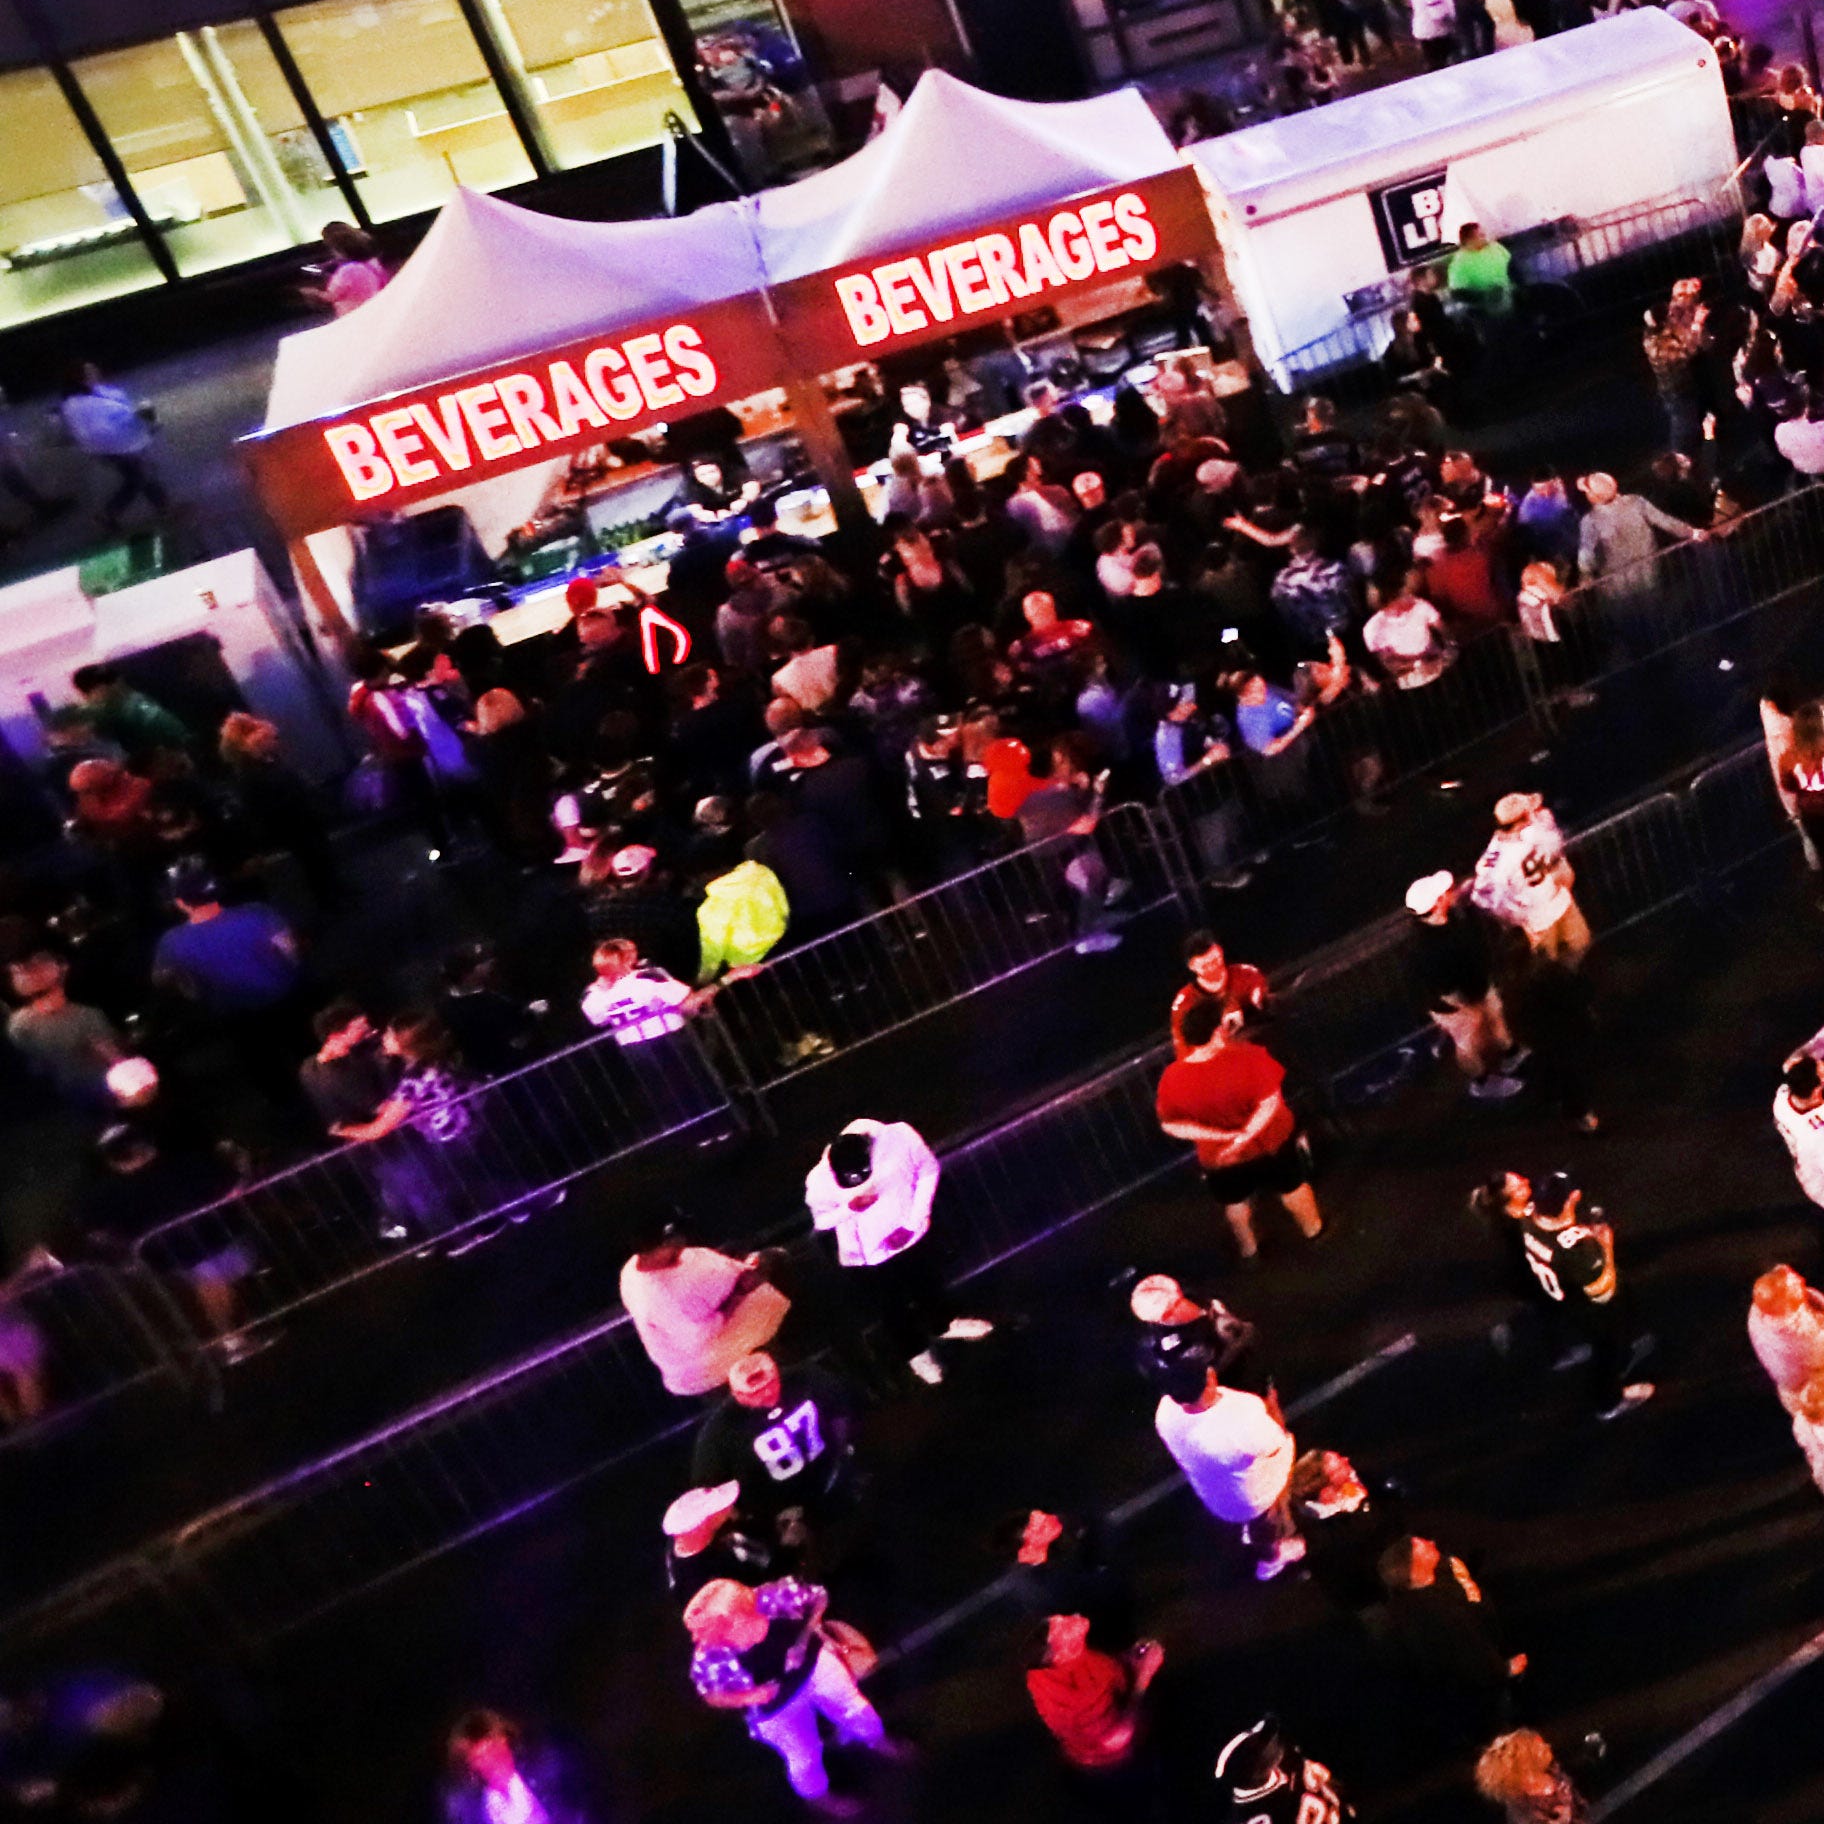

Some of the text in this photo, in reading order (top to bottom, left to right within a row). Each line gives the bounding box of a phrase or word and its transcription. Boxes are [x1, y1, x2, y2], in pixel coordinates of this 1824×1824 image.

[833, 191, 1157, 348] BEVERAGES
[324, 323, 719, 503] BEVERAGES
[754, 1399, 827, 1482] 87
